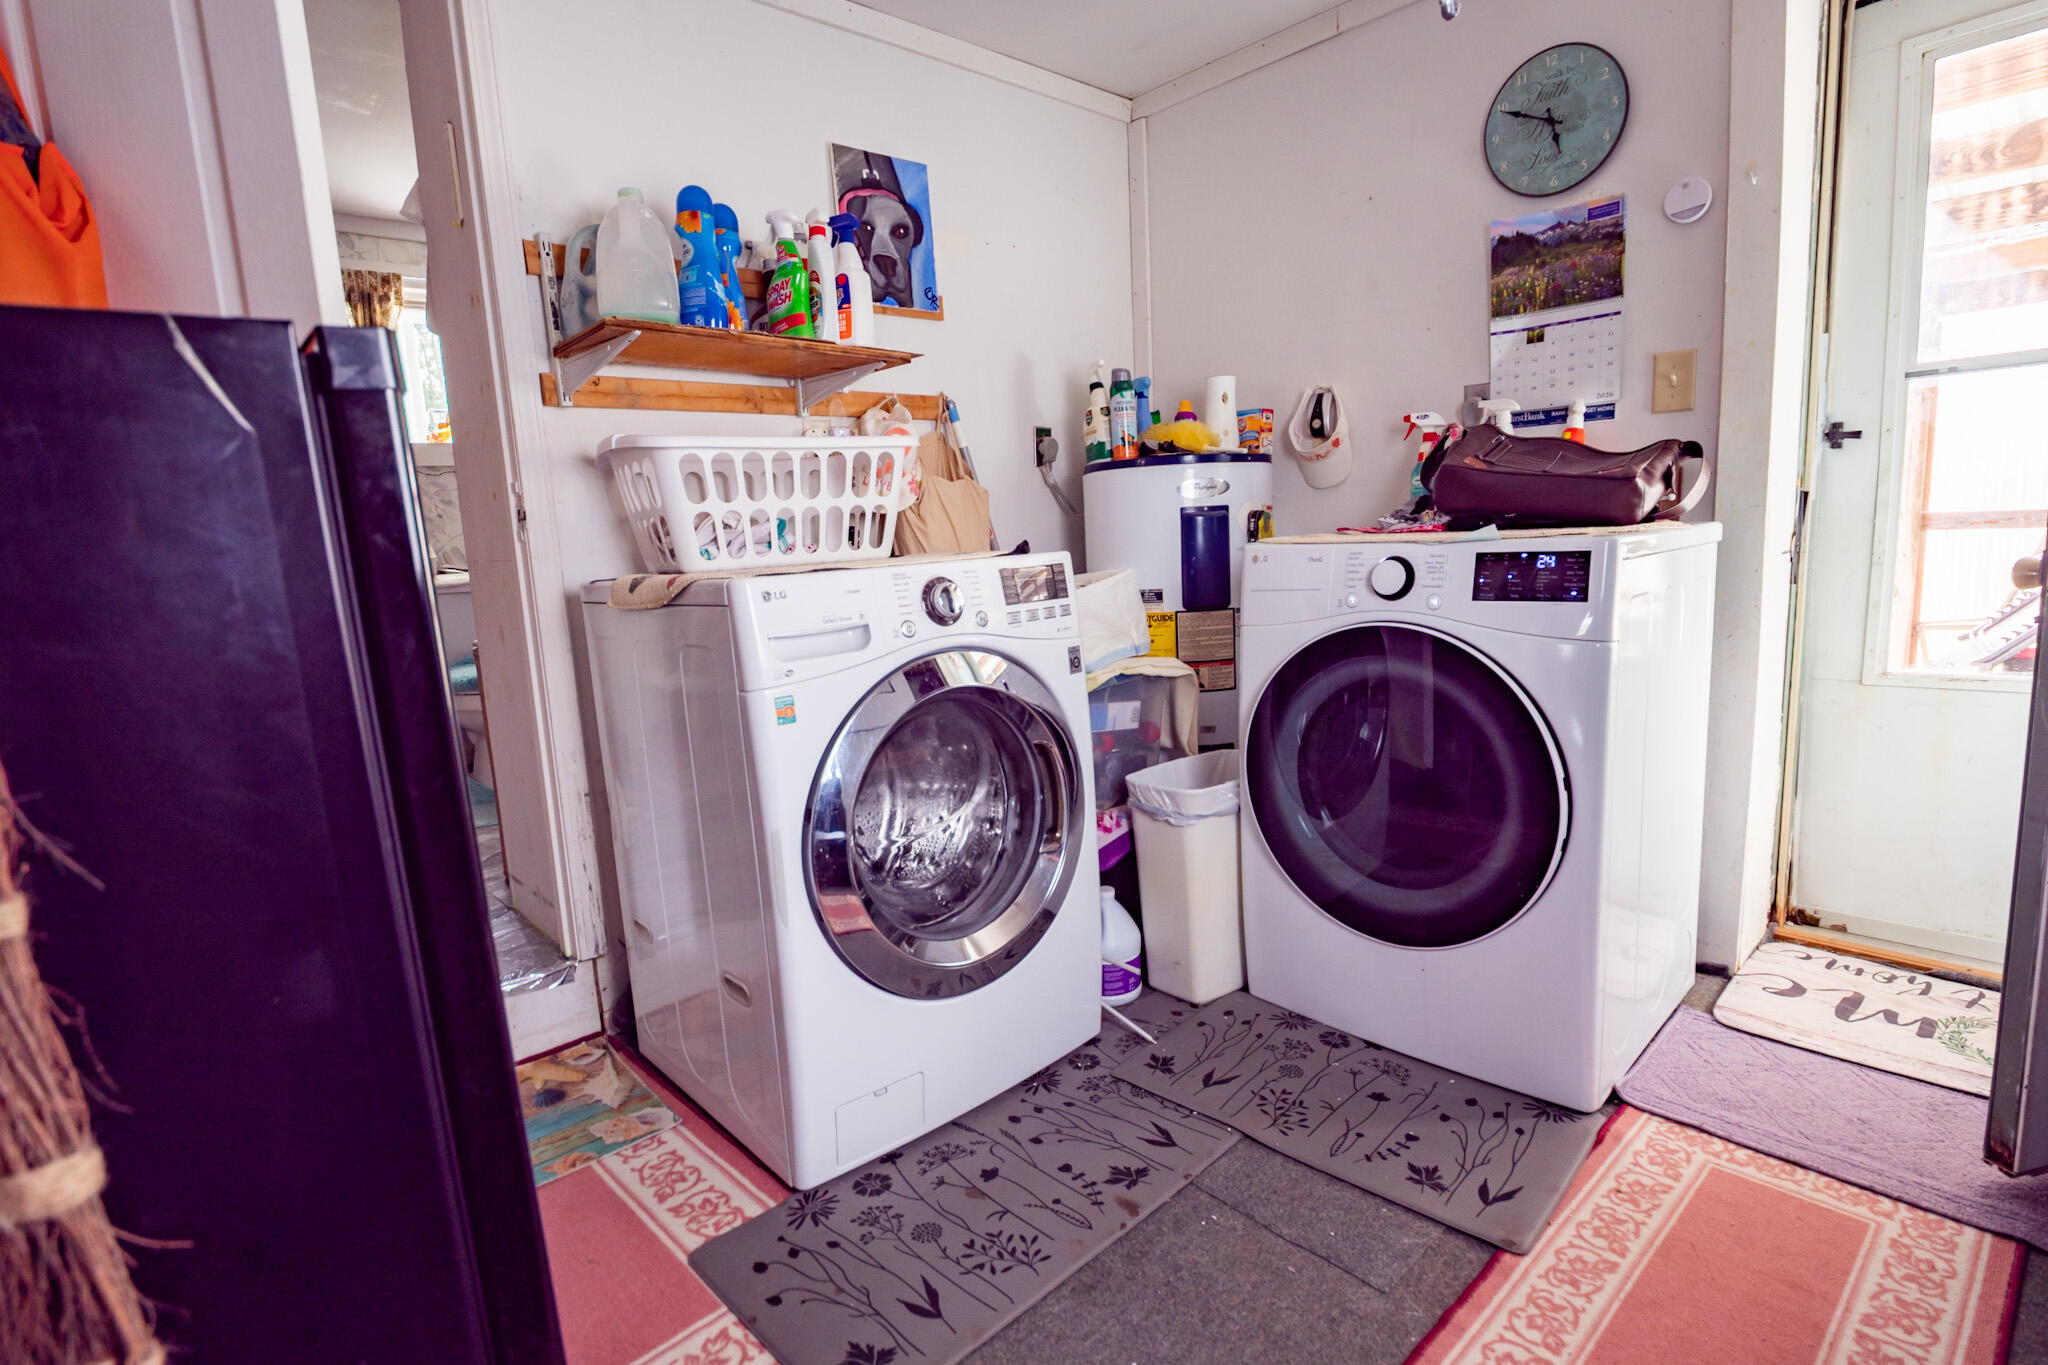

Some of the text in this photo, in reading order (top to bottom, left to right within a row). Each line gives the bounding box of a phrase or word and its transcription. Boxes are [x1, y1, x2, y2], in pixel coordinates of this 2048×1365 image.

[1545, 53, 1558, 67] 12
[1579, 53, 1585, 63] 1
[1516, 73, 1528, 85] 11
[1602, 67, 1611, 79] 2
[1610, 96, 1619, 108] 3
[1491, 135, 1499, 145] 9
[1602, 129, 1611, 141] 4
[1500, 161, 1508, 172] 8
[1580, 159, 1588, 171] 5
[1521, 176, 1529, 187] 7
[1550, 175, 1558, 187] 6
[768, 290, 793, 311] WASH
[1537, 554, 1556, 568] 24
[774, 591, 788, 600] LG
